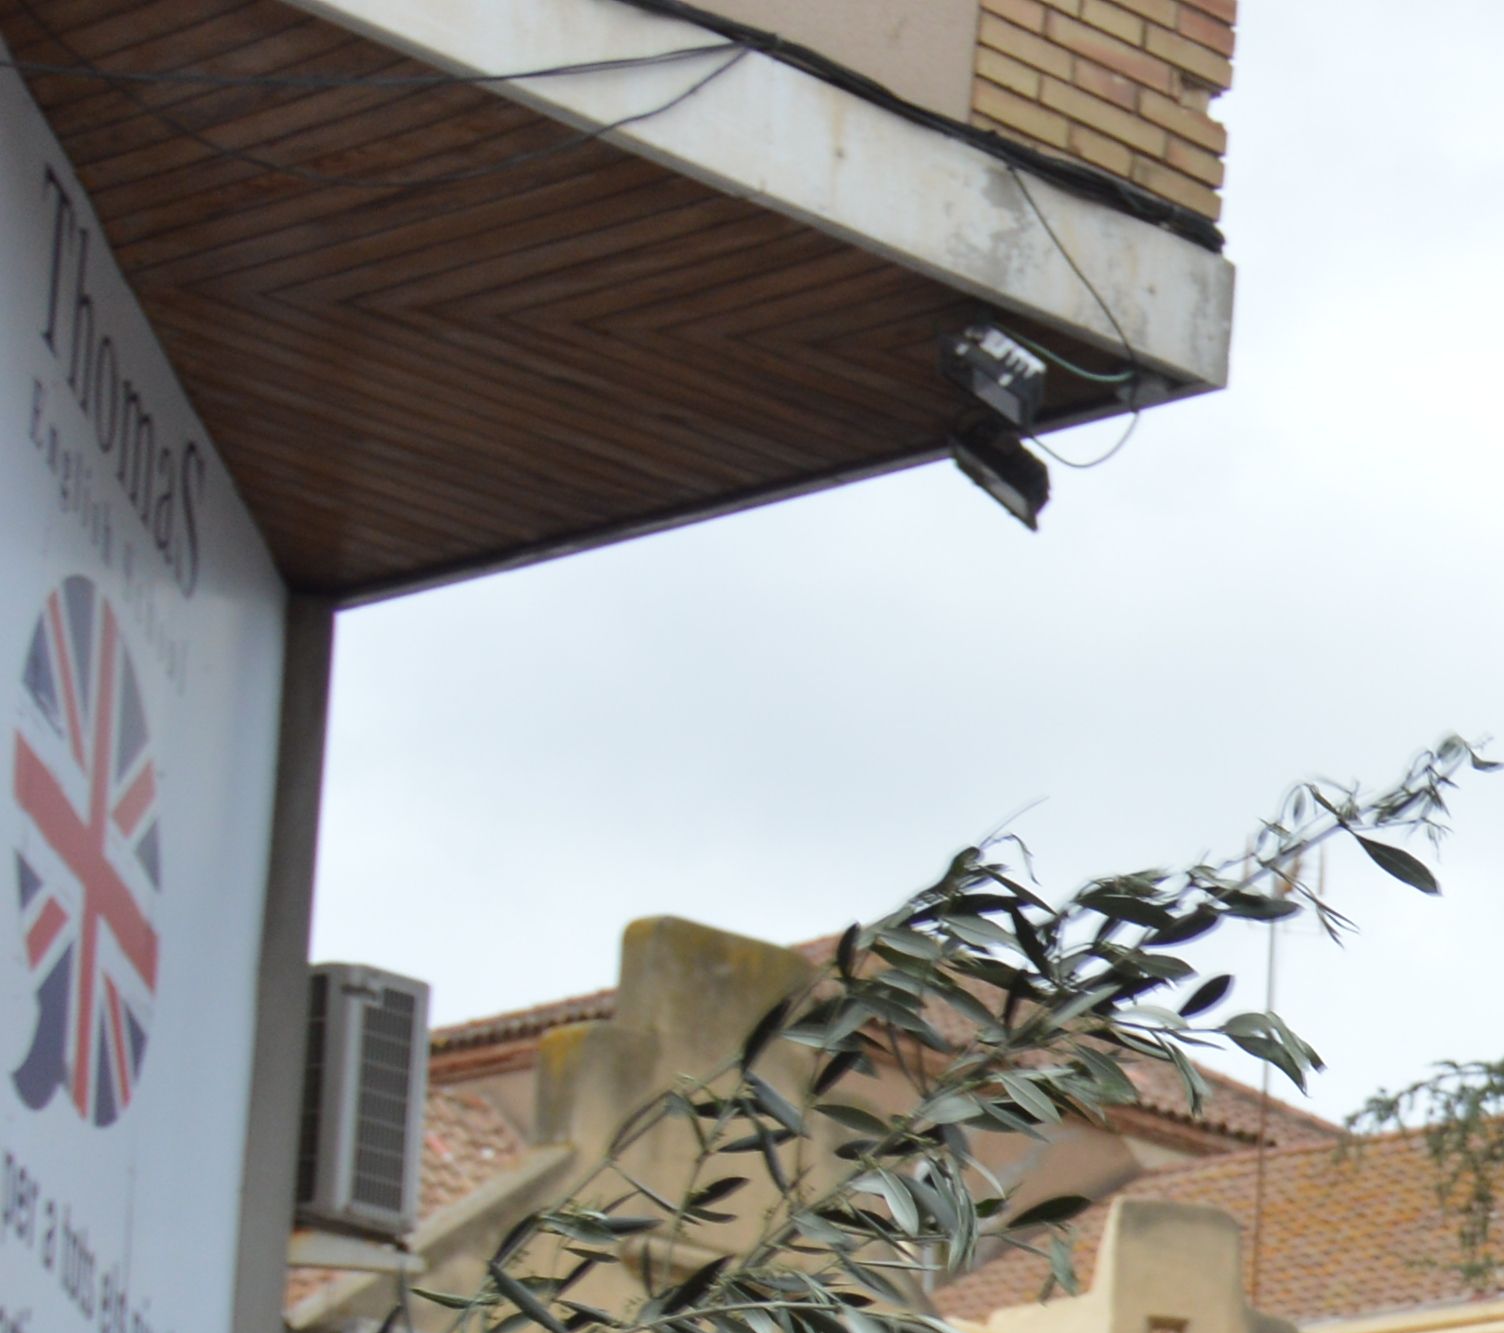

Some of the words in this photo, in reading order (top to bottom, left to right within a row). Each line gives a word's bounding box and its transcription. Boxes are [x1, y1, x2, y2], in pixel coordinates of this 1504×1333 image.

[1, 1151, 40, 1249] per
[41, 1199, 57, 1273] a
[60, 1202, 97, 1320] tots
